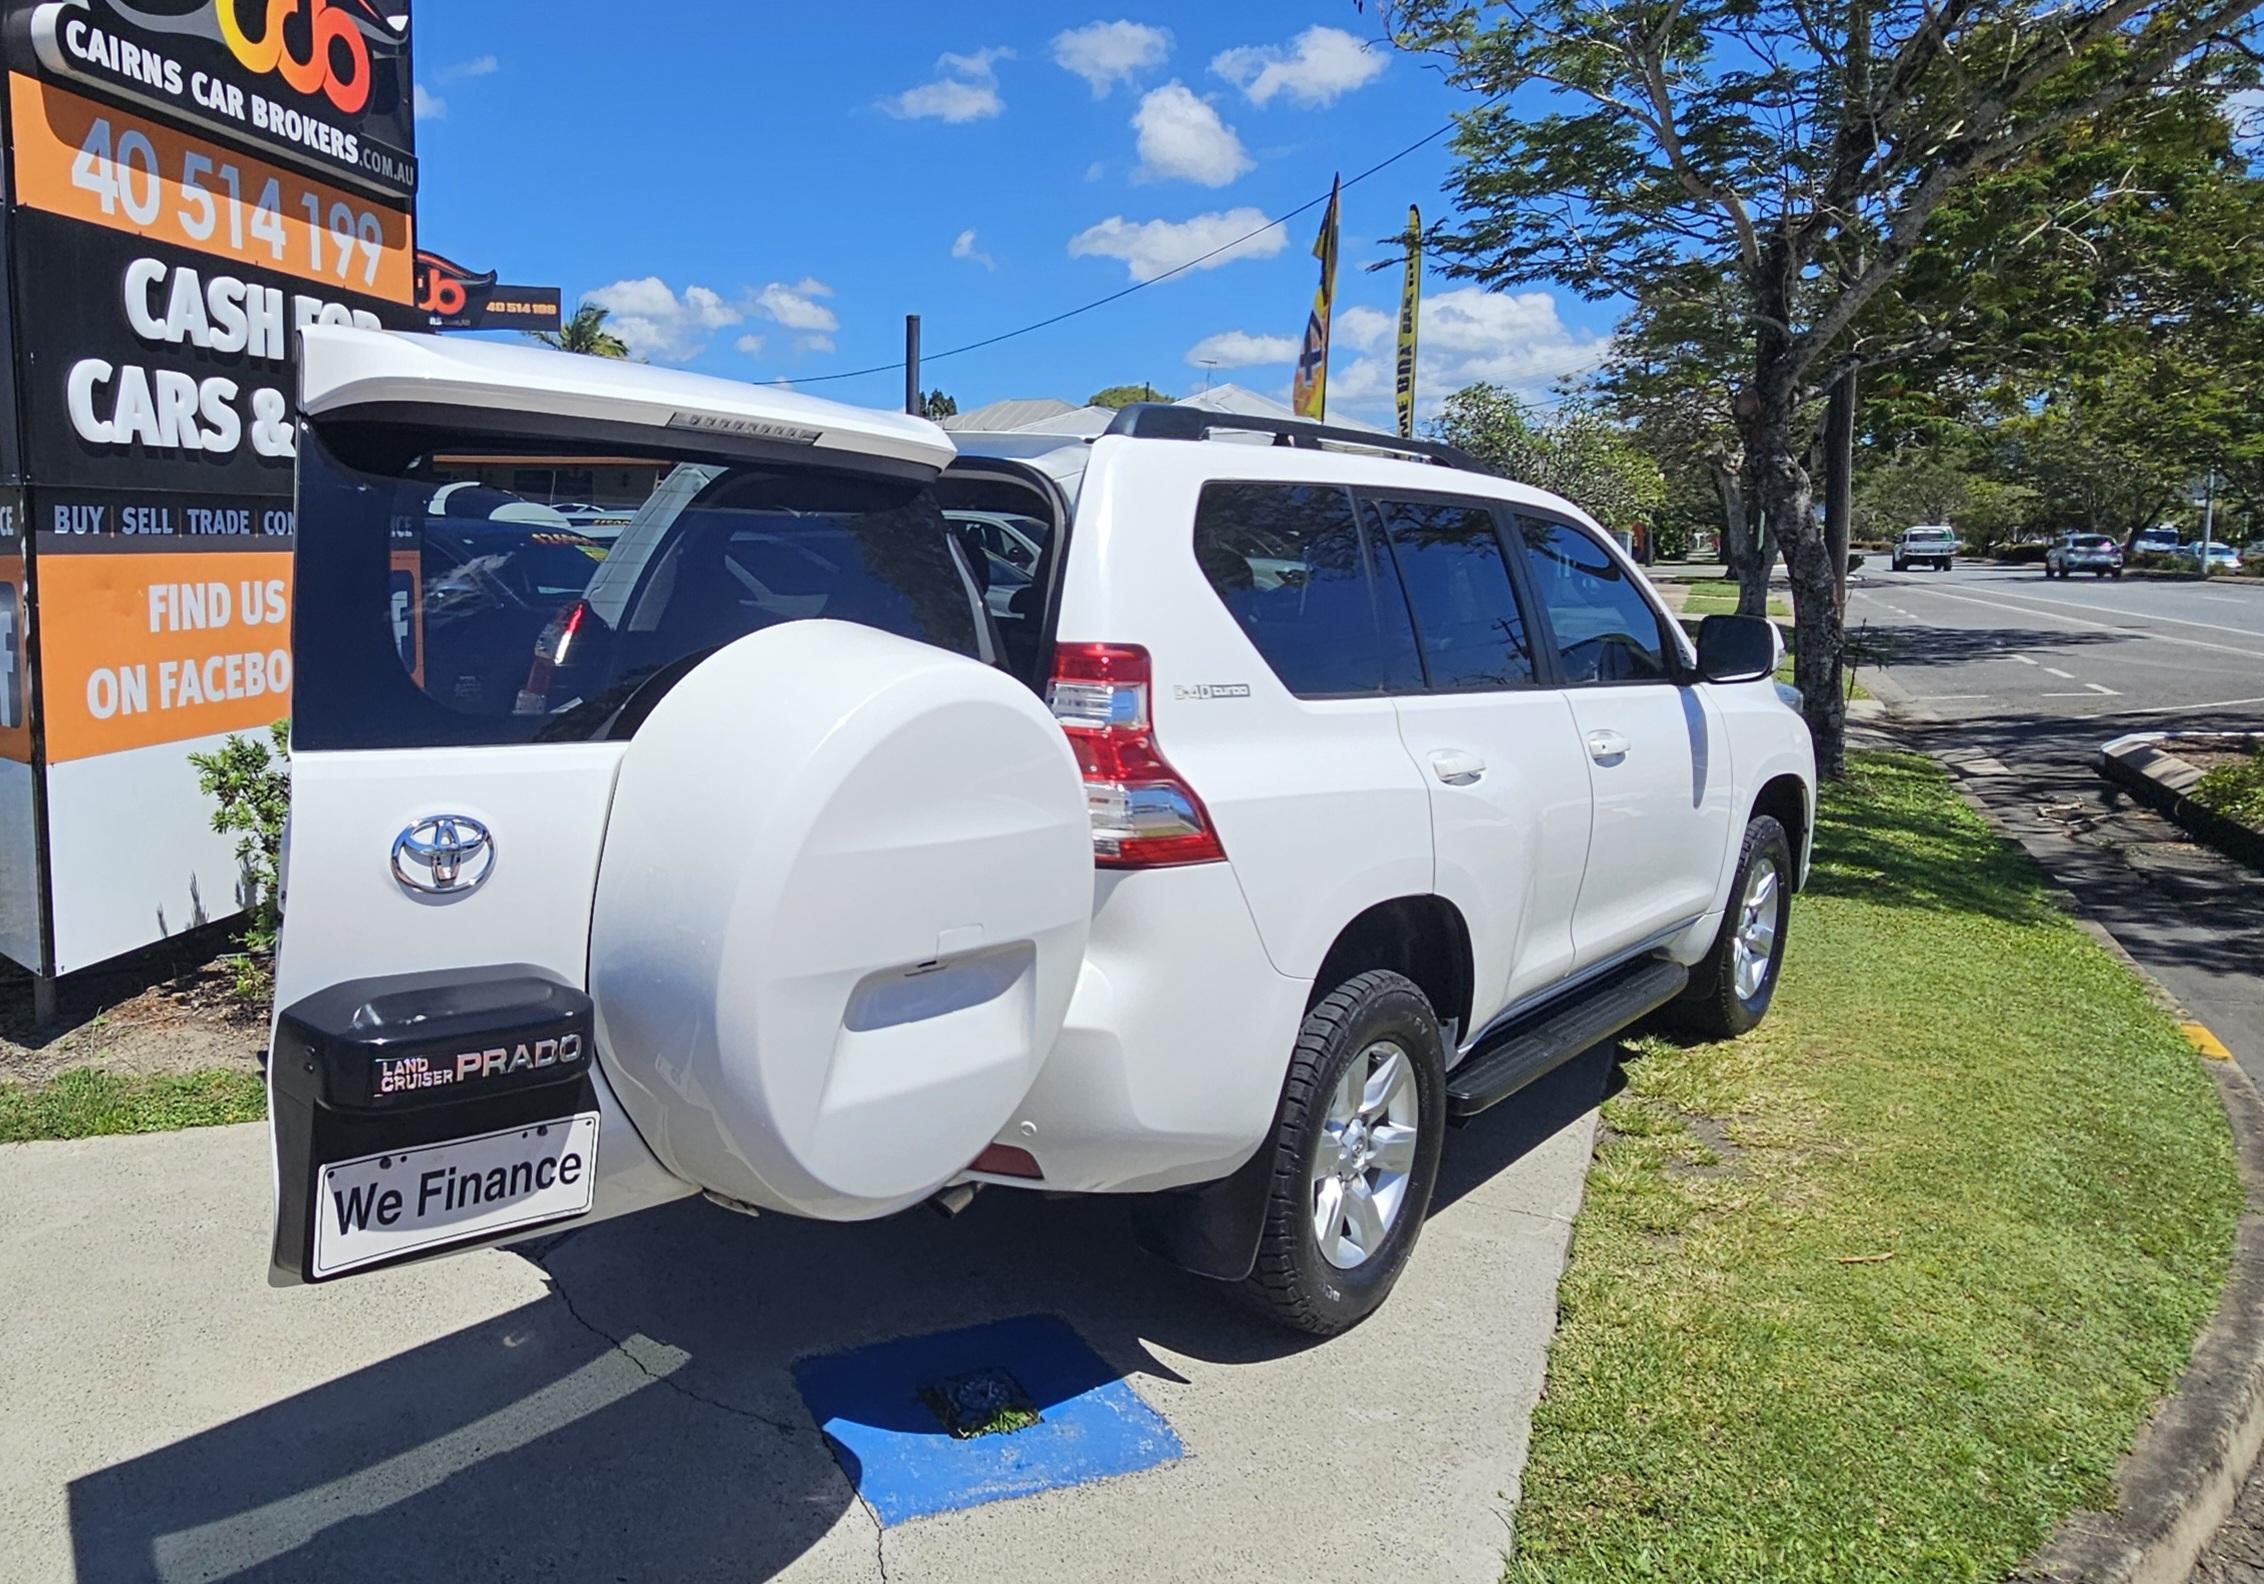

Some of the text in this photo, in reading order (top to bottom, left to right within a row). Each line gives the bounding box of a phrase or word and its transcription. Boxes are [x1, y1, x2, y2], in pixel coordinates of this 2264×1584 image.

[66, 20, 183, 95] CAIRNS
[191, 71, 246, 120] CAR
[71, 117, 383, 287] 40 514 199
[124, 257, 285, 361] CASH
[67, 358, 297, 458] CARS &
[53, 505, 105, 535] BUY
[121, 506, 174, 535] SELL
[187, 508, 251, 535] TRADE
[148, 579, 287, 633] FIND US
[86, 649, 292, 720] ON FACEBO
[380, 1068, 454, 1093] CRUISER
[381, 1033, 583, 1082] LAND PRADO
[333, 1152, 582, 1236] We Finance
